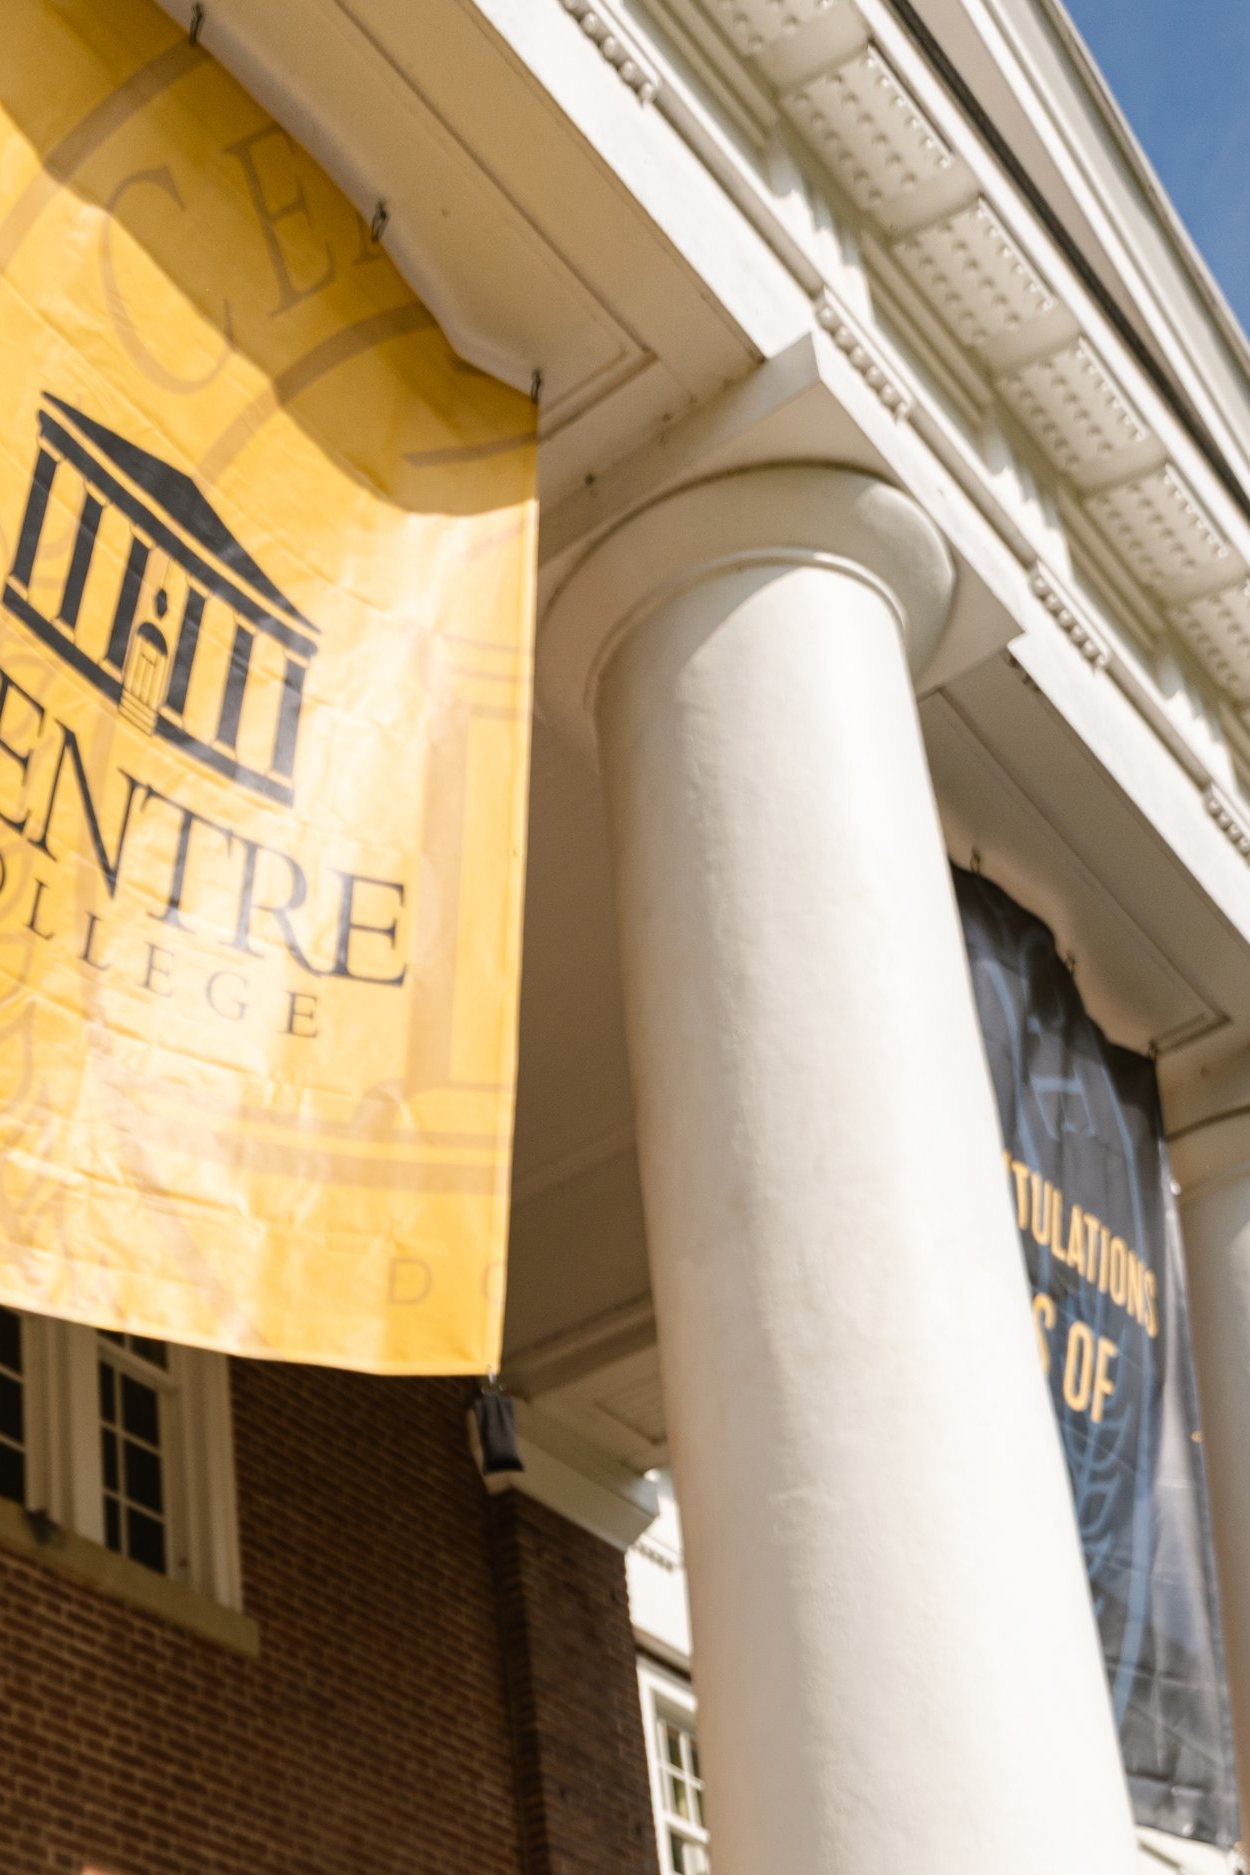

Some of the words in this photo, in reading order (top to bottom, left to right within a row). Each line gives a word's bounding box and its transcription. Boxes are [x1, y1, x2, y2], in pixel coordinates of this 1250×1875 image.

[100, 122, 382, 394] CE
[1003, 1149, 1159, 1339] TULATIONS
[1063, 1320, 1119, 1425] OF
